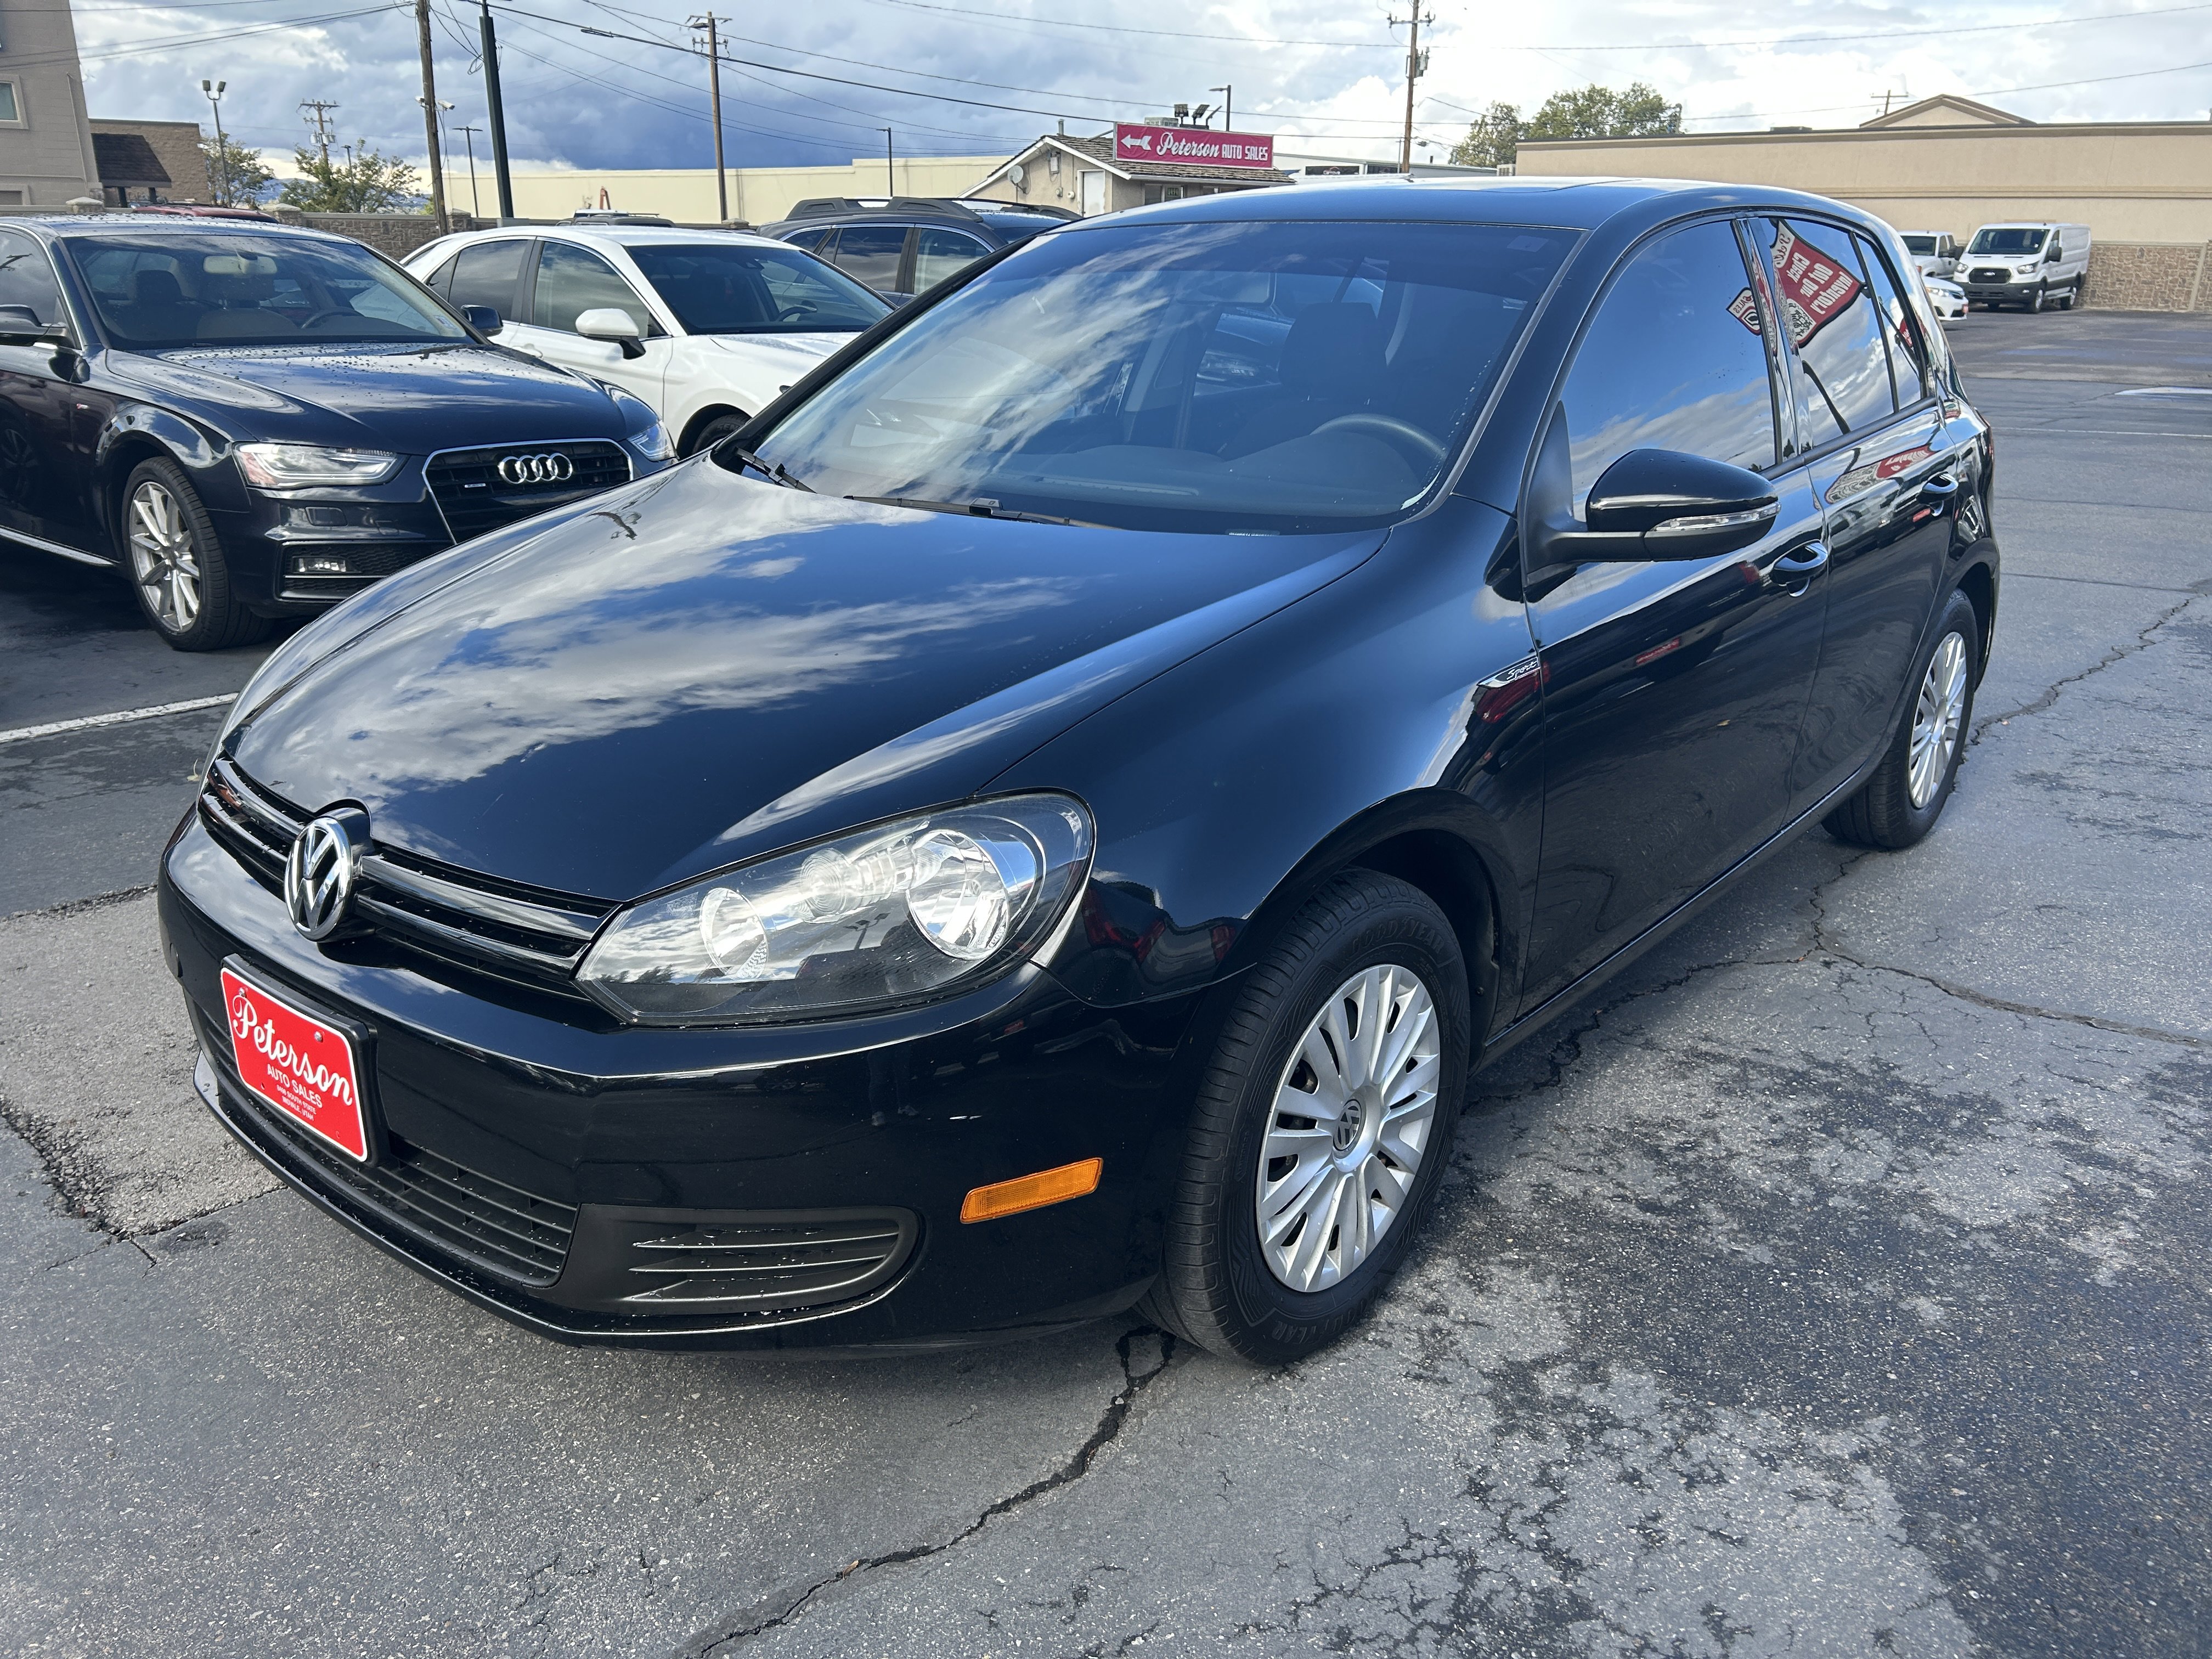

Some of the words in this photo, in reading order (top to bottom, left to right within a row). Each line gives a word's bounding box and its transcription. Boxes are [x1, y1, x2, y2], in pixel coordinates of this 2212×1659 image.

[1156, 132, 1220, 157] Peterson
[1222, 144, 1242, 159] AUTO
[1245, 145, 1268, 161] SALES
[1506, 661, 1538, 681] Sport
[233, 994, 353, 1106] Peterson
[267, 1063, 291, 1088] AUTO
[291, 1079, 323, 1109] SALES
